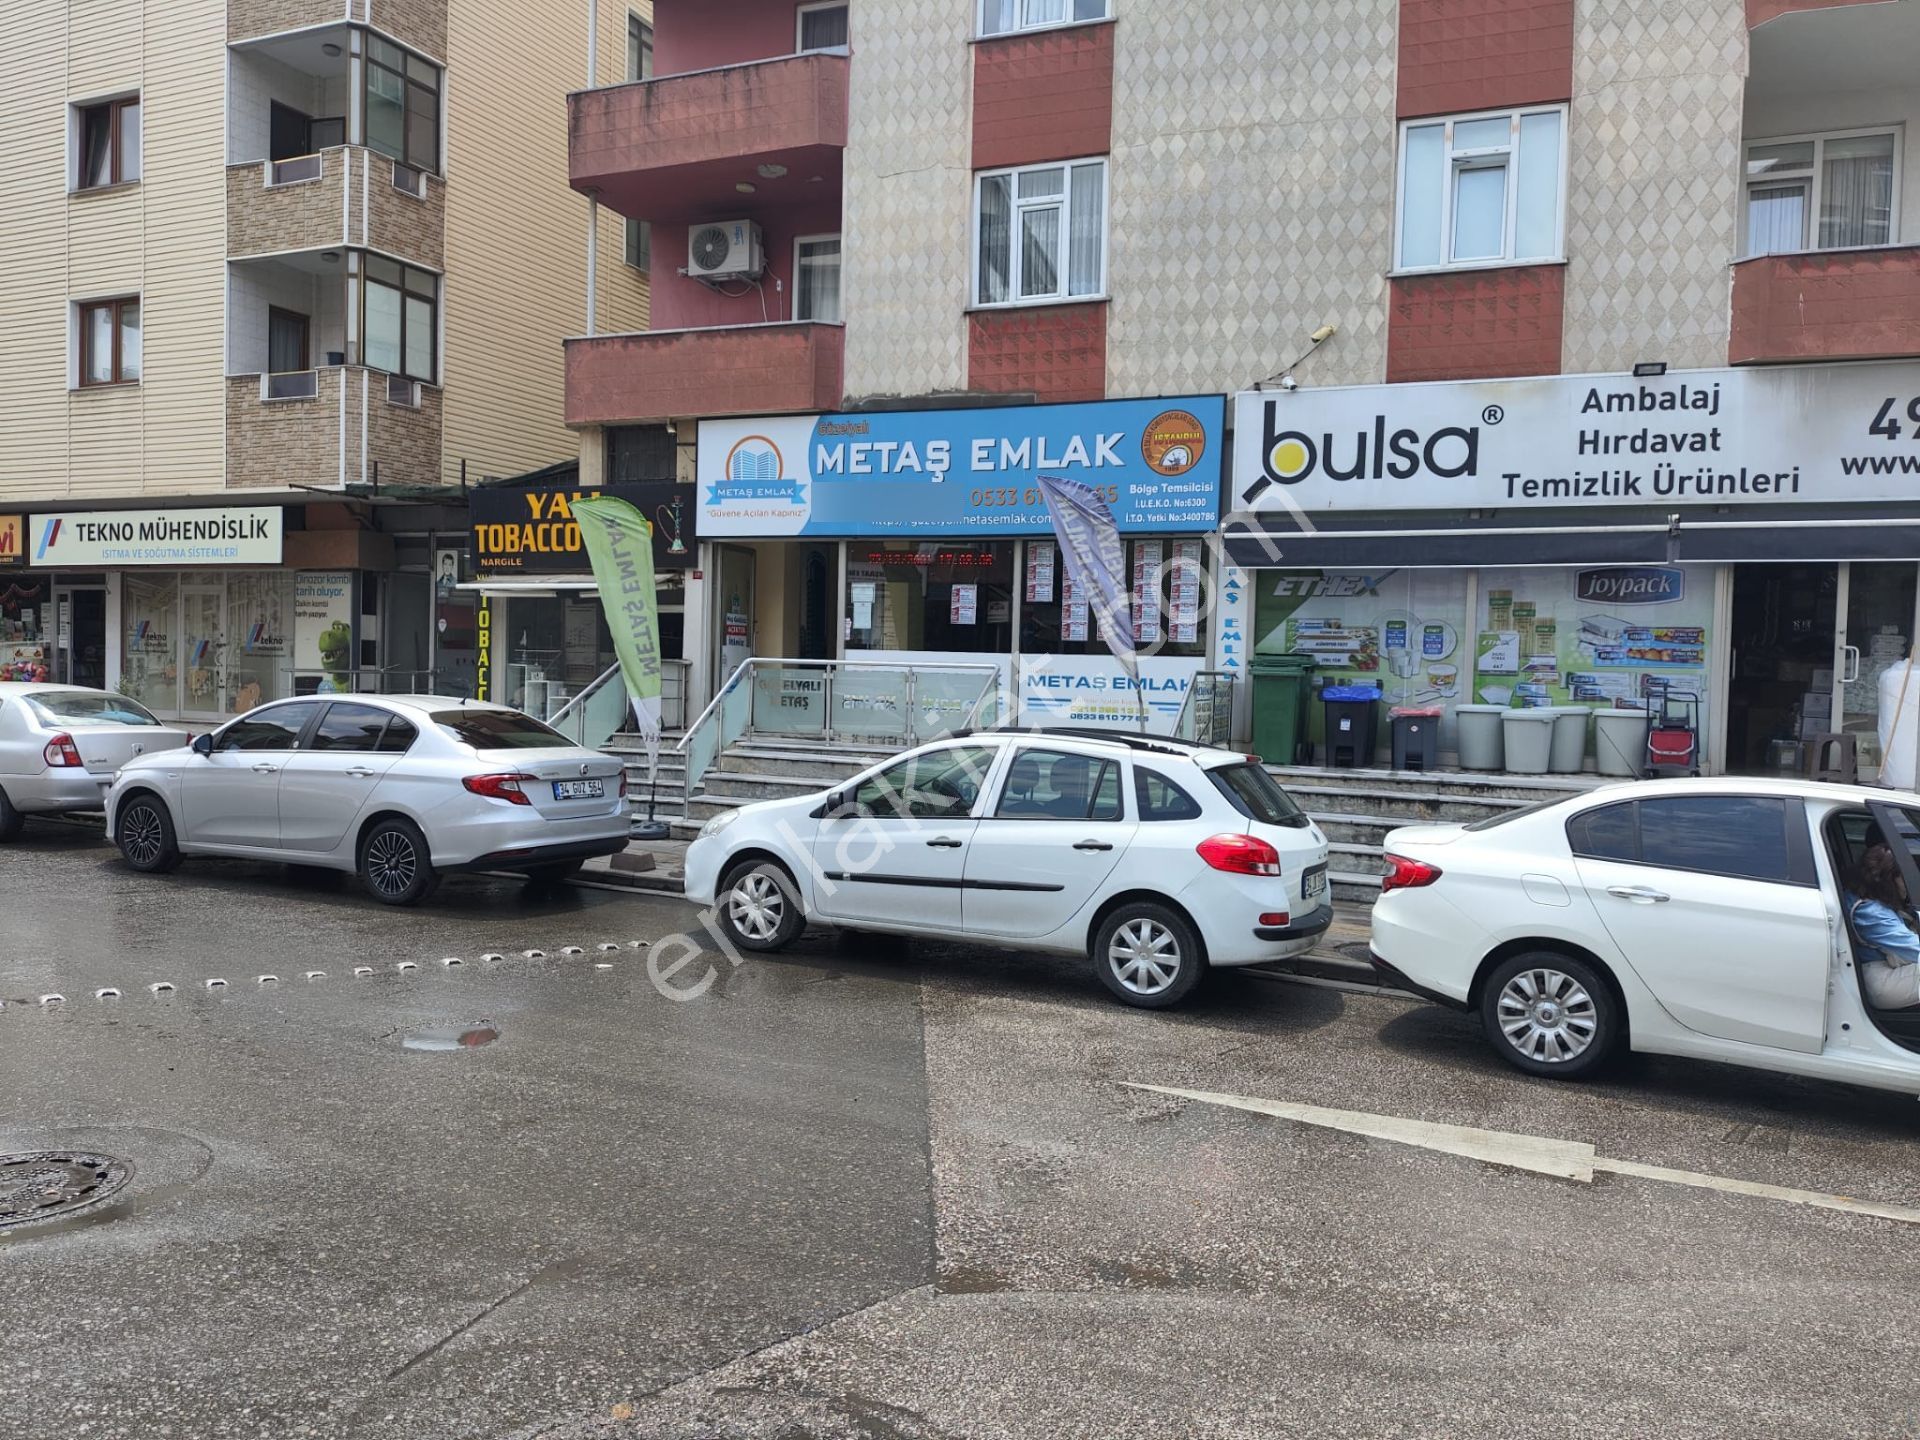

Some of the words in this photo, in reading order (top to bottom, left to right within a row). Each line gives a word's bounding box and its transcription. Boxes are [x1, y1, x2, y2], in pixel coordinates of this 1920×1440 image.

[1581, 383, 1720, 416] Ambalaj
[1262, 400, 1479, 485] bulsa
[1578, 428, 1721, 455] Hırdavat
[816, 440, 951, 483] METAŞ
[970, 432, 1126, 471] EMLAK
[1129, 484, 1158, 496] Bölge
[1161, 482, 1213, 494] Temsilcisi
[1502, 470, 1641, 498] Temizlik
[1653, 463, 1800, 496] Ürünleri
[717, 488, 753, 498] METAŞ
[757, 487, 795, 496] EMLAK
[970, 488, 1018, 506] 0533
[1174, 498, 1206, 508] No:6300
[744, 509, 770, 519] Açılan
[1147, 512, 1167, 522] Yetki
[76, 521, 134, 543] TEKNO
[139, 513, 269, 542] MÜHENDİSLİK
[475, 522, 581, 553] TOBACCO
[132, 549, 142, 559] VE
[144, 547, 186, 559] SOĞUTMA
[188, 546, 239, 558] SİSTEMLERİ
[296, 585, 315, 597] tarih
[316, 586, 345, 599] oluyor.
[1273, 575, 1380, 598] ETHEX
[1584, 575, 1672, 597] joypack
[260, 635, 284, 646] tekno
[1028, 675, 1107, 692] METAŞ
[559, 783, 570, 795] 34
